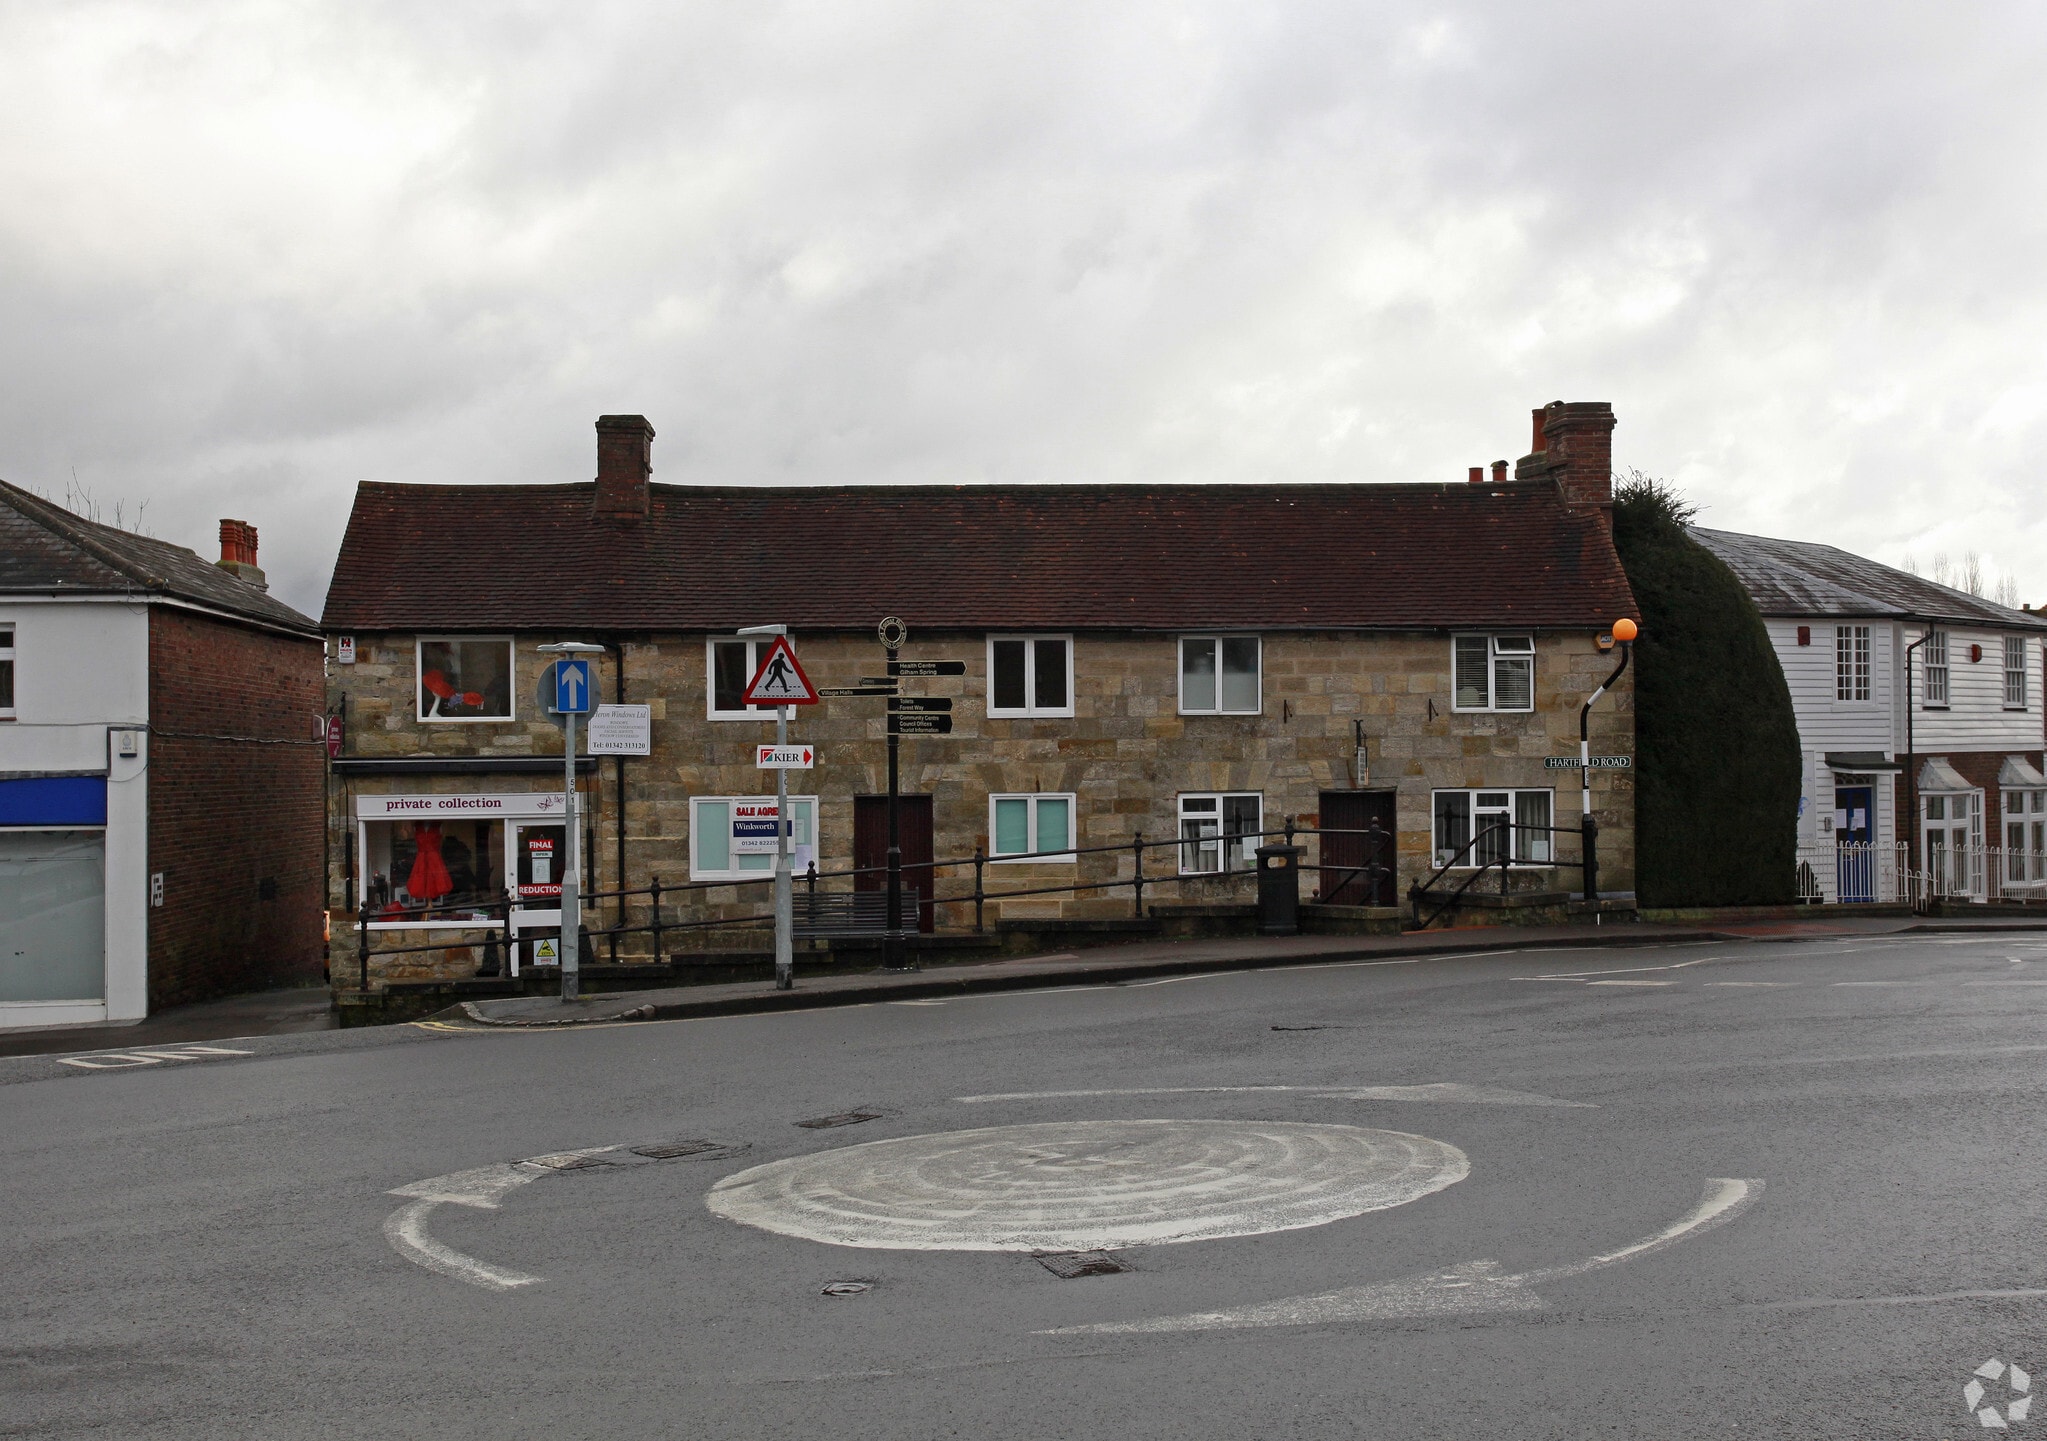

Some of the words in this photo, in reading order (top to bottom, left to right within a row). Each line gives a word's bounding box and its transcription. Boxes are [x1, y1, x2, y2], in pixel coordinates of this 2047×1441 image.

[774, 753, 799, 762] KIER
[1550, 758, 1599, 767] HARTFID
[1600, 757, 1627, 767] ROAD
[386, 798, 432, 812] private
[438, 797, 502, 809] collection
[736, 807, 755, 816] SALE
[757, 806, 779, 816] AGRE
[736, 822, 775, 830] Winkworth
[529, 841, 553, 849] FINAL
